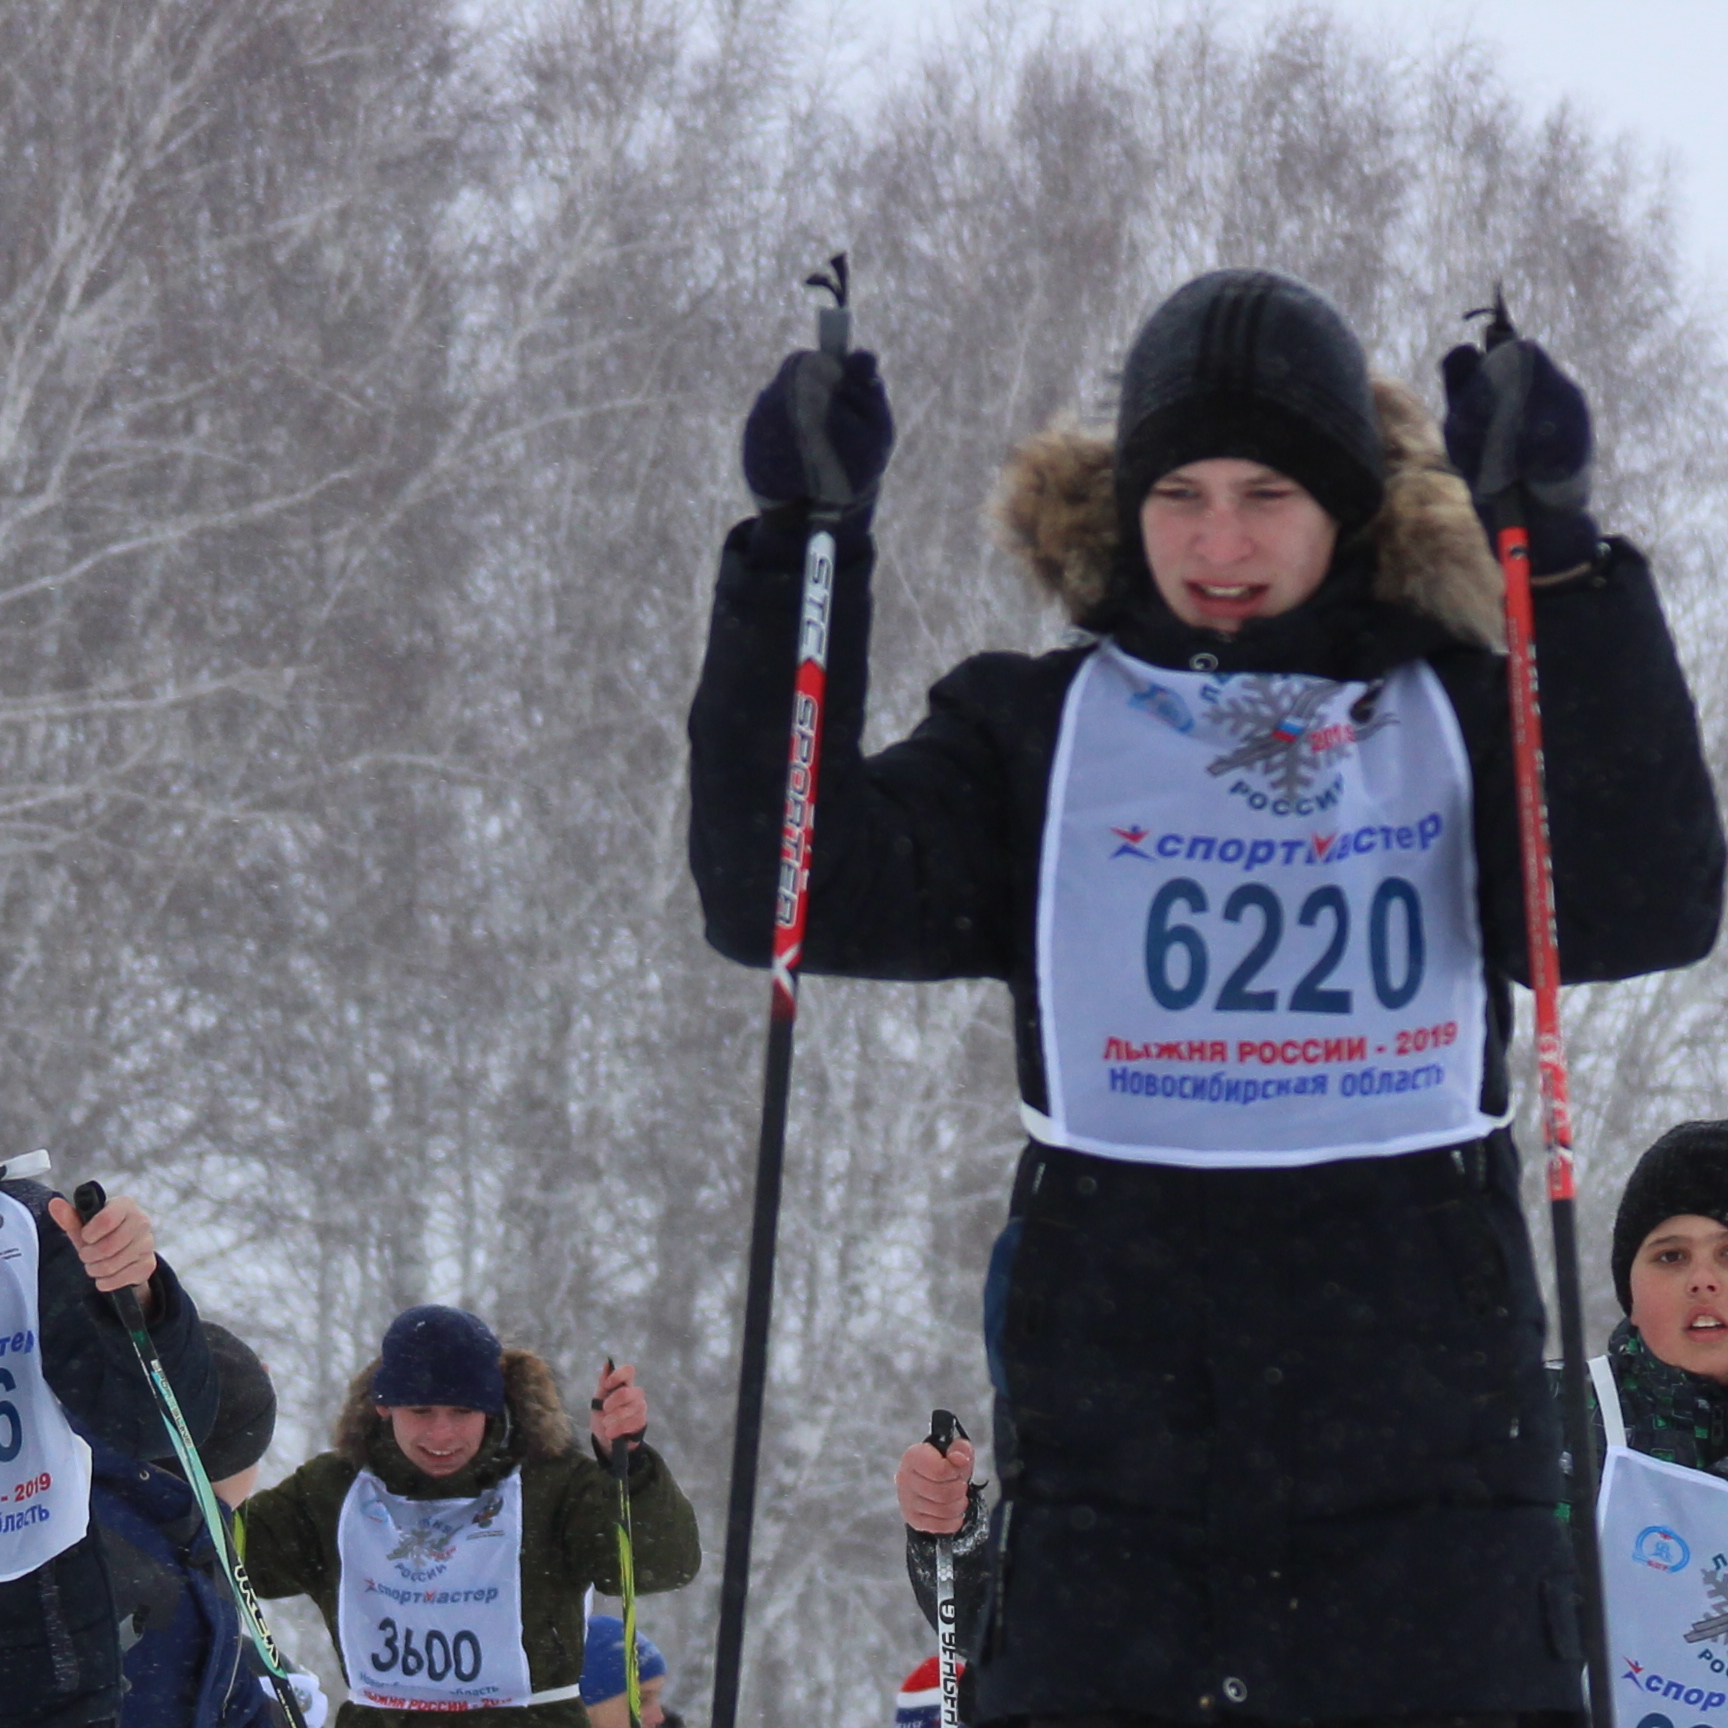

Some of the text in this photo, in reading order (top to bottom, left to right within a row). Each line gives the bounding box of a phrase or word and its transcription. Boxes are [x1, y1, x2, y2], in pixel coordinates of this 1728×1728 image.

[1143, 876, 1427, 1014] 6220
[1103, 1036, 1229, 1065] ЛЫЖНЯ
[1237, 1036, 1369, 1065] РОССИИ
[1395, 1020, 1459, 1056] 2019
[1108, 1066, 1329, 1105] Новосибирская
[14, 1471, 52, 1503] 2019
[370, 1616, 483, 1683] 3600
